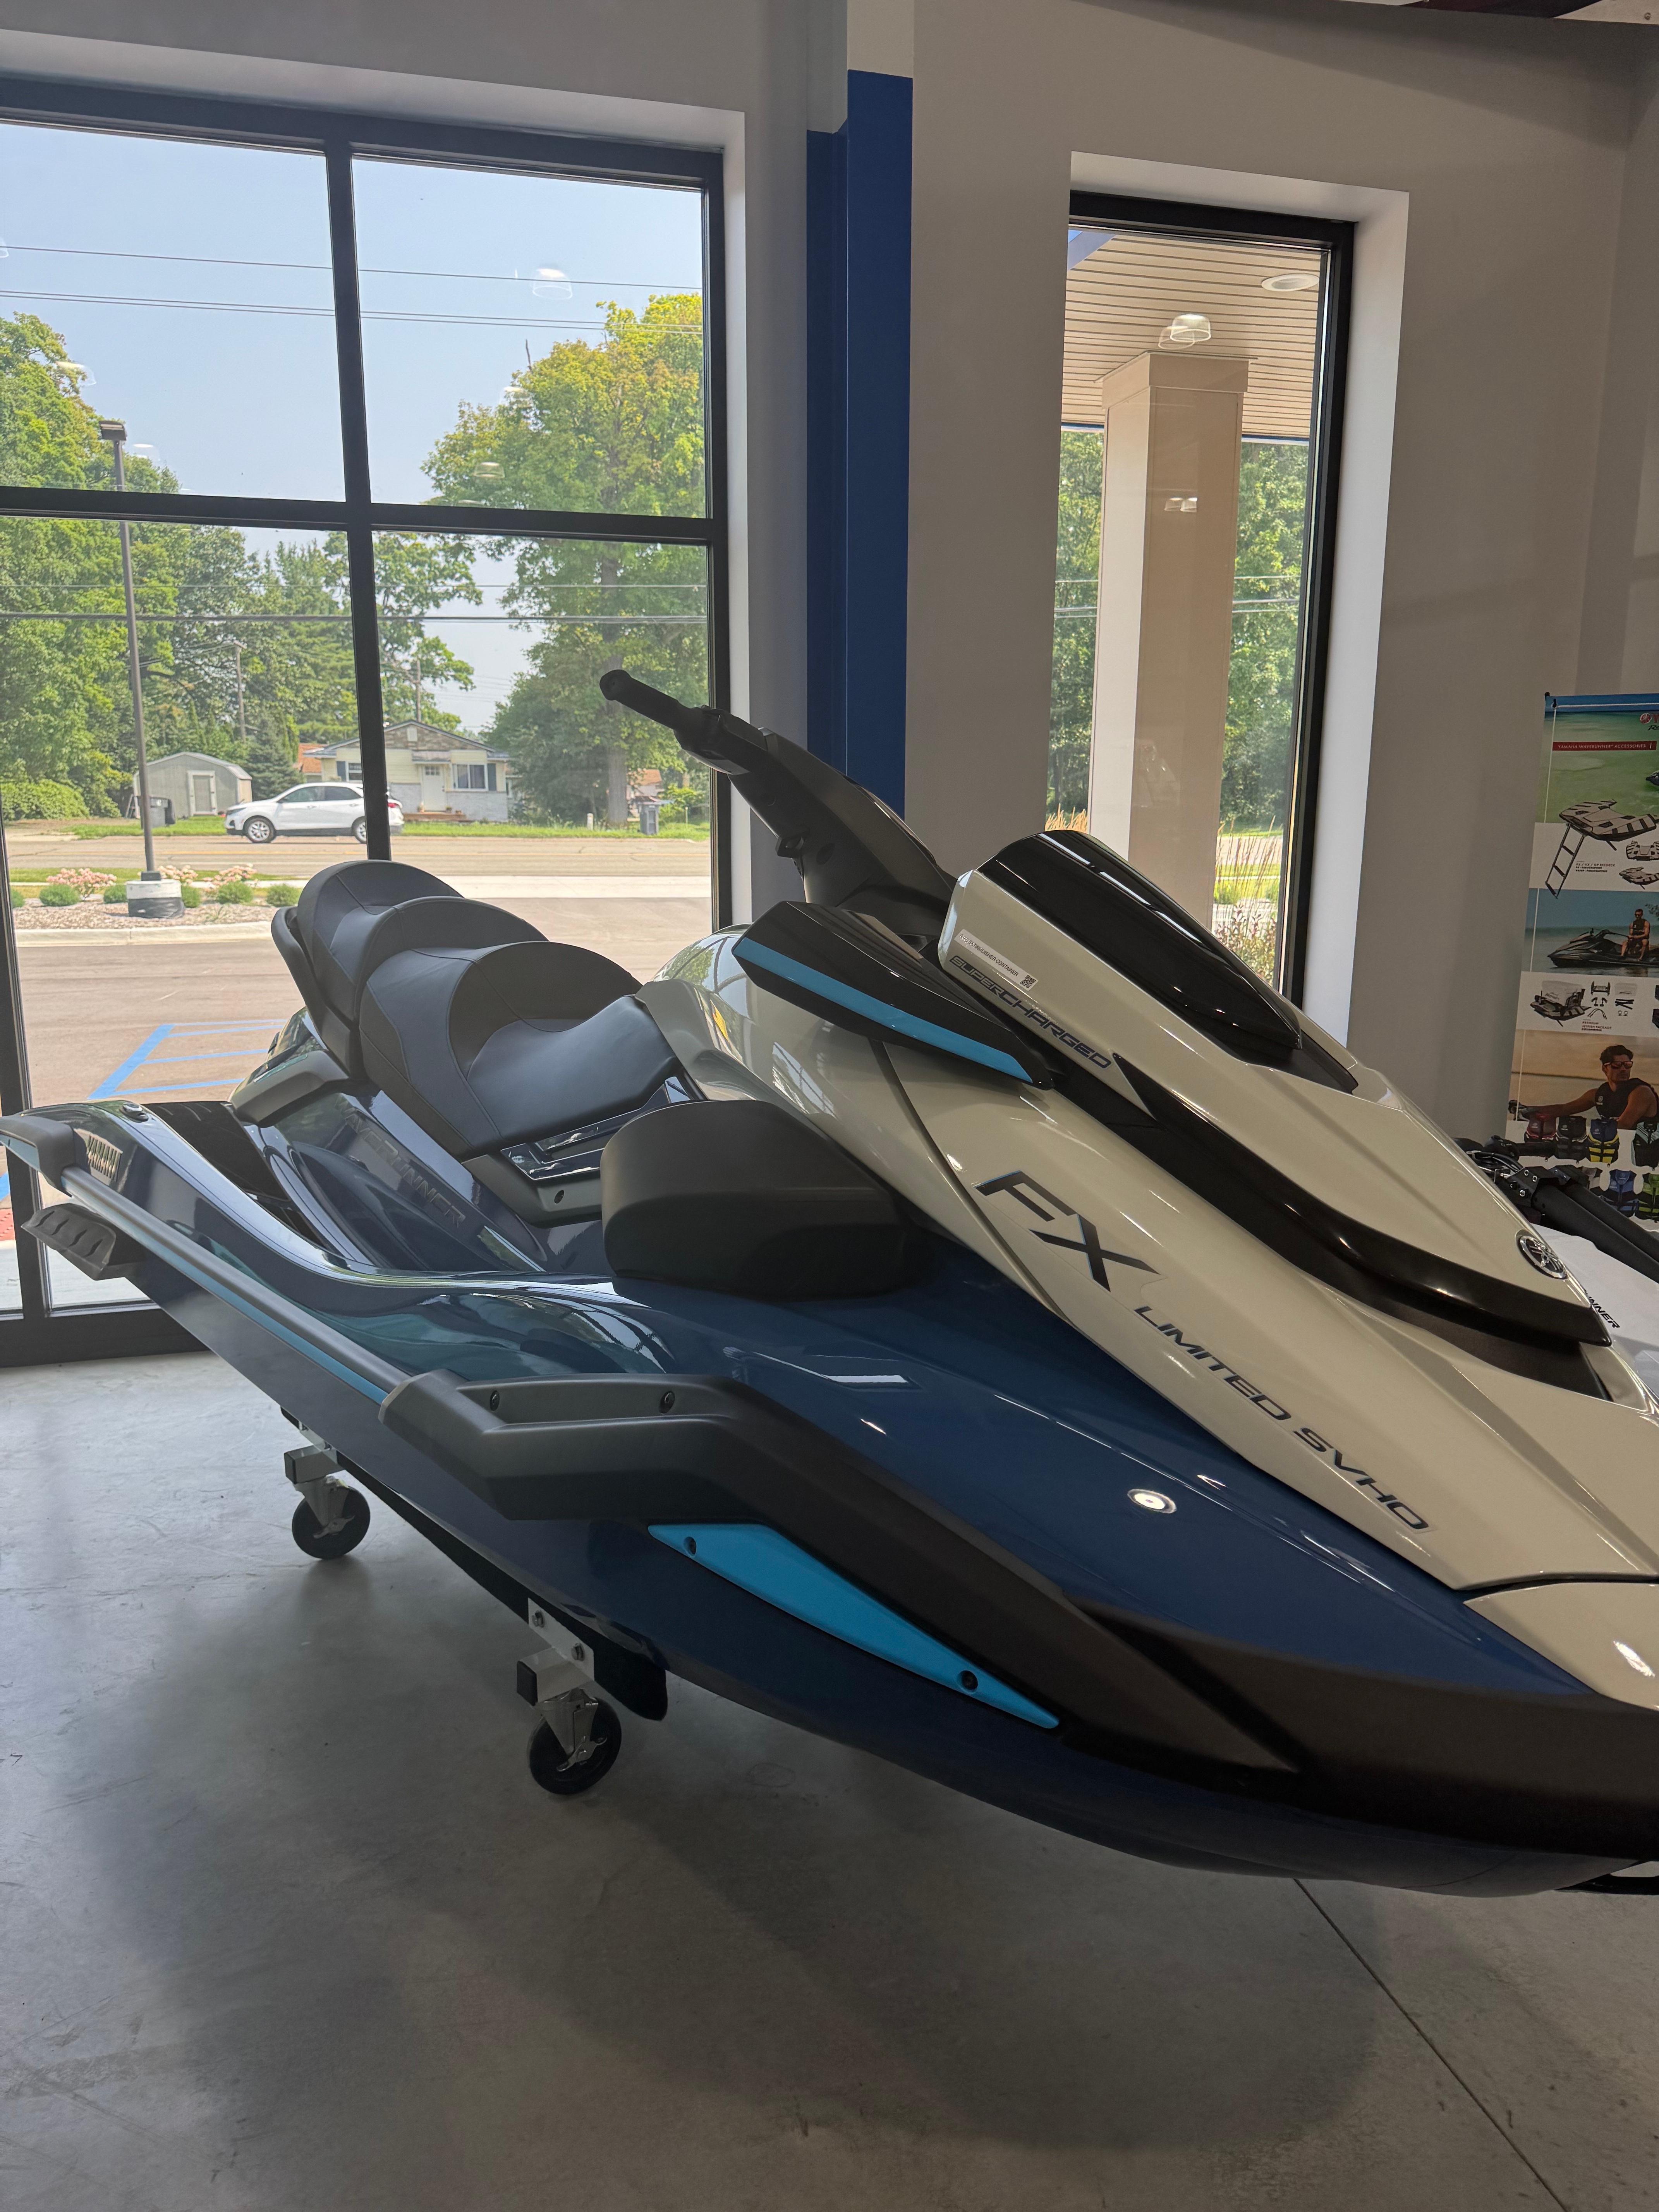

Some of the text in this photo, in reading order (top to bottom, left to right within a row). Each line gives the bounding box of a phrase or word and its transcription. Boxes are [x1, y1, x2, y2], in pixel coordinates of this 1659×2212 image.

[949, 955, 1111, 1070] SUPERCHARGED
[996, 959, 1019, 977] CONTAINER
[334, 1095, 466, 1228] WAVERUNNER
[972, 1170, 1161, 1292] FX
[1134, 1306, 1429, 1530] LIMITED SVHO
